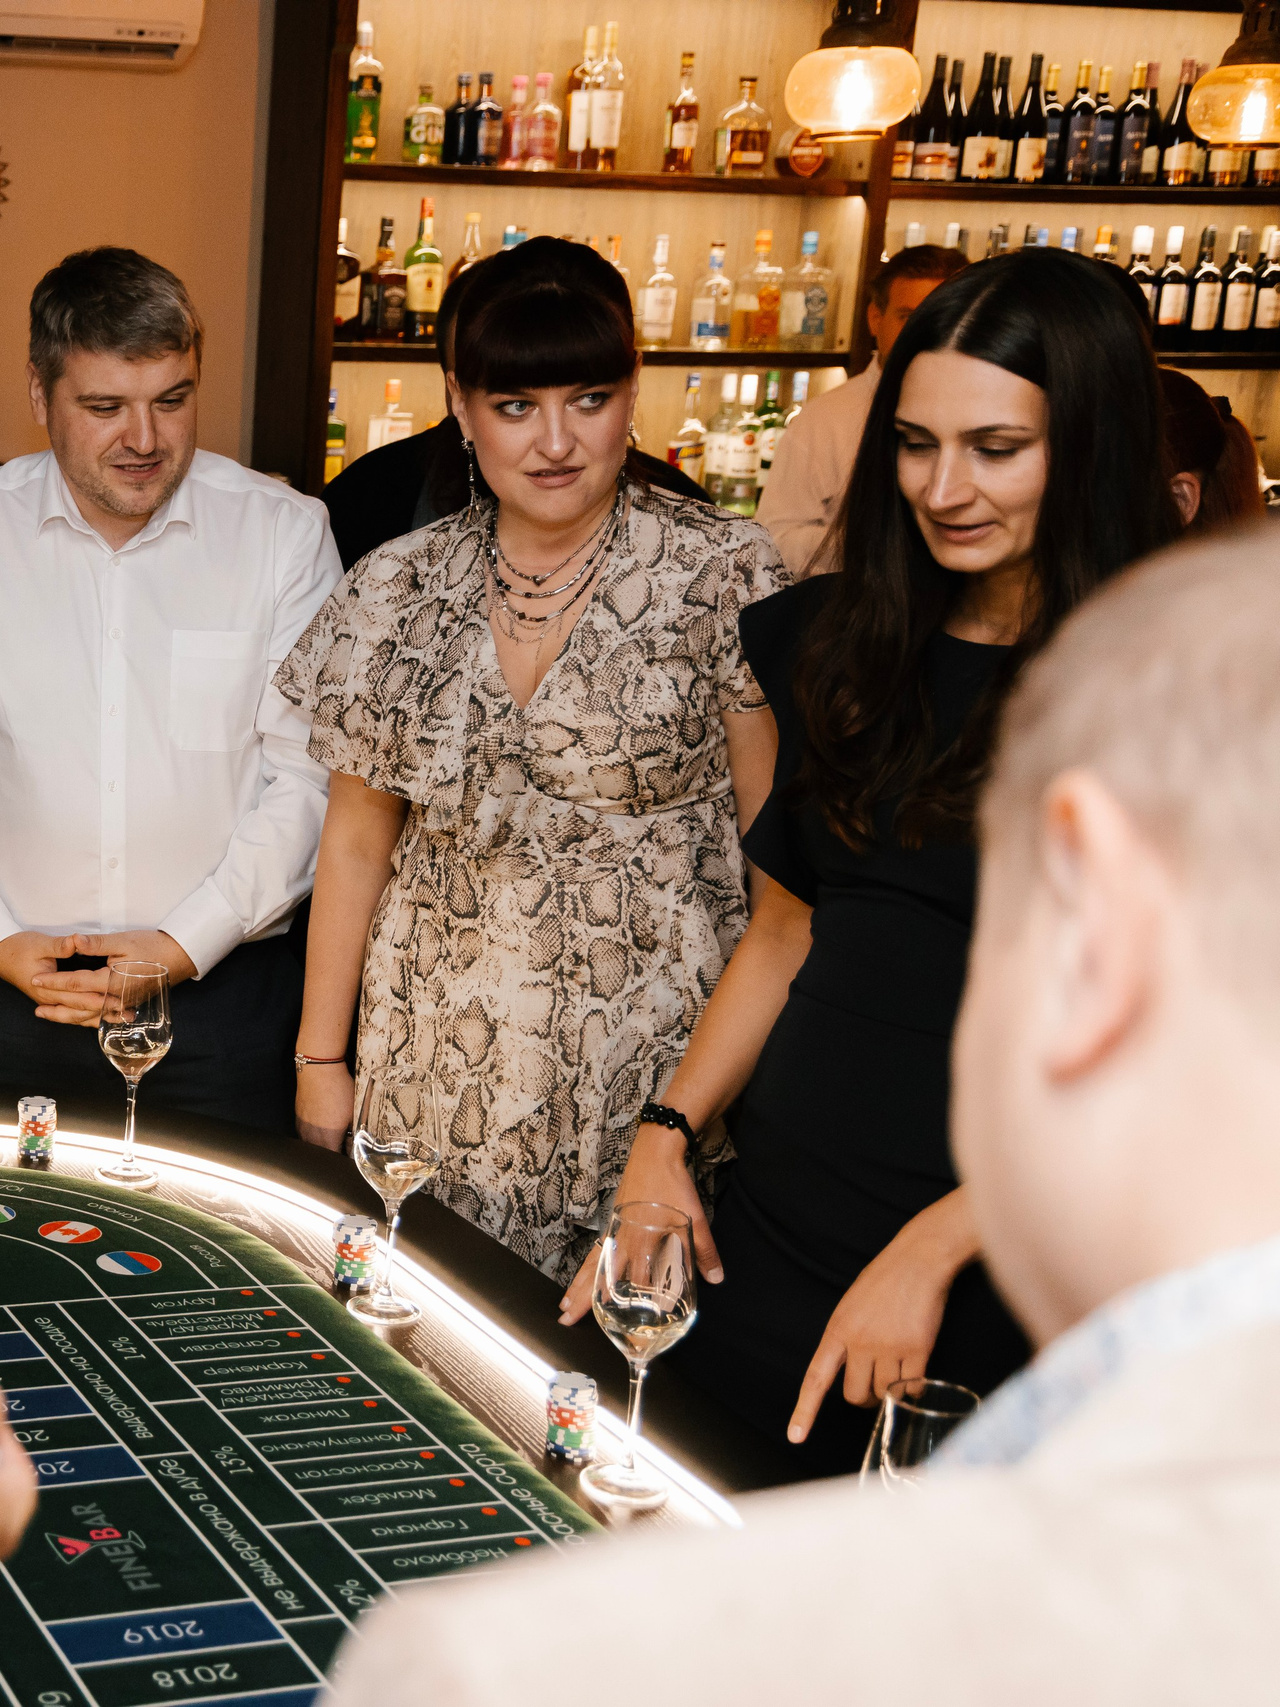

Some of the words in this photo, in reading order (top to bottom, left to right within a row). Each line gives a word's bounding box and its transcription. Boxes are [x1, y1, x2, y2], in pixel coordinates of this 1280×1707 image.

[86, 1202, 143, 1223] Канада
[189, 1244, 226, 1268] Россия
[150, 1296, 217, 1310] Другой
[146, 1312, 264, 1328] Монастрель
[168, 1321, 261, 1336] Мурведр/
[34, 1316, 78, 1355] осадке
[180, 1338, 281, 1353] Саперави
[108, 1336, 147, 1360] 14%
[68, 1356, 94, 1371] на
[203, 1360, 308, 1376] Карменер
[220, 1378, 331, 1396] Примитиво
[221, 1387, 349, 1407] Зинфандель/
[83, 1372, 154, 1439] выдержано
[258, 1408, 351, 1424] Пинотаж
[13, 1429, 50, 1443] 20
[260, 1432, 413, 1453] Монтепульчано
[36, 1460, 75, 1476] 20
[211, 1445, 254, 1475] 13%
[294, 1459, 425, 1480] Красностоп
[458, 1443, 518, 1486] сорта
[158, 1458, 204, 1491] дубе
[188, 1492, 209, 1502] в
[342, 1487, 437, 1506] Мальбек
[510, 1487, 587, 1546] расные
[371, 1518, 469, 1538] Гарнача
[198, 1503, 284, 1587] выдержано
[392, 1546, 509, 1568] Неббиоло
[273, 1588, 306, 1611] не
[122, 1619, 205, 1644] 2019
[151, 1662, 239, 1688] 2018
